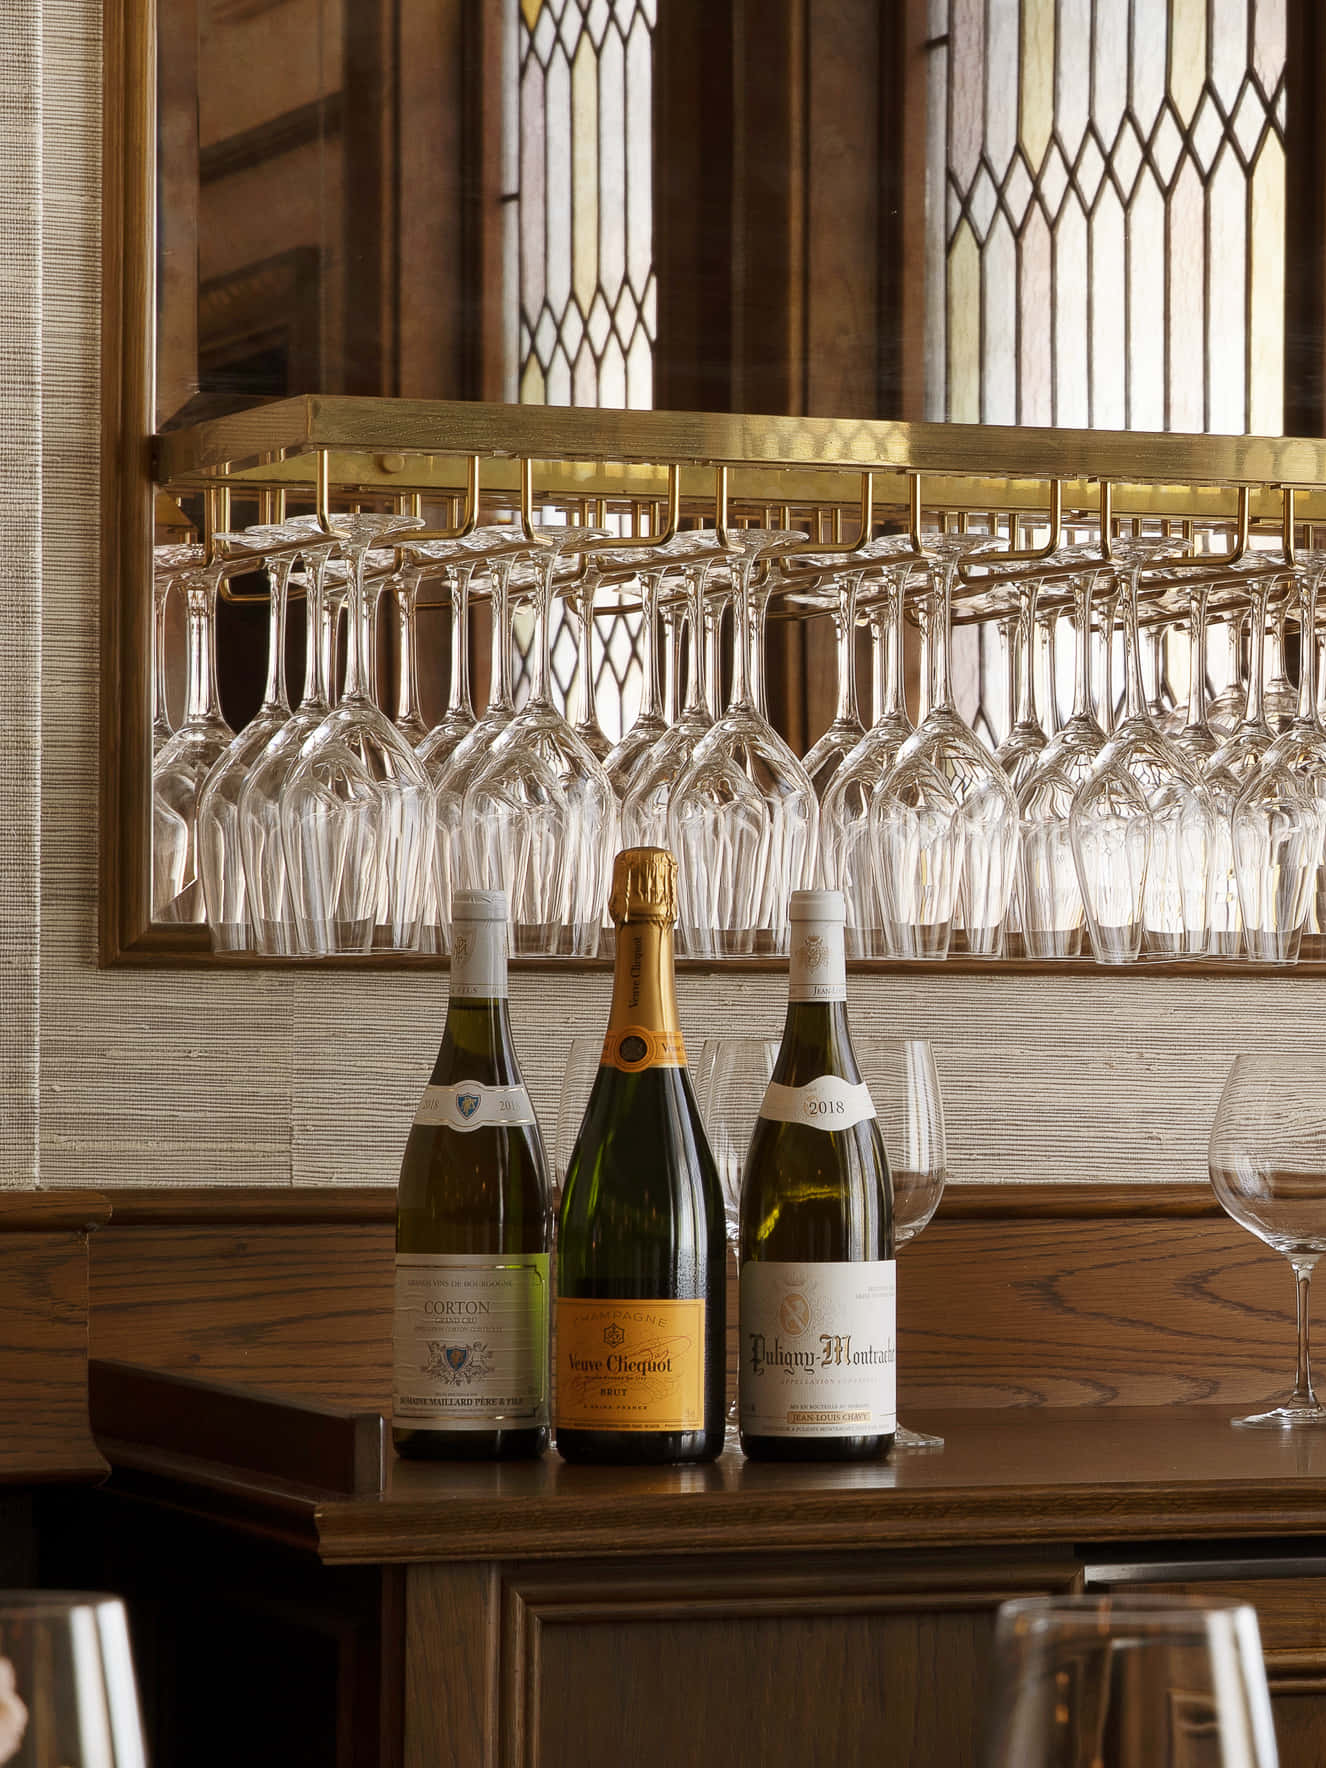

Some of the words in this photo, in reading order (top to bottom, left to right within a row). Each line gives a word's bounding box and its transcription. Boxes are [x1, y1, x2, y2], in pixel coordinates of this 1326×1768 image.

[809, 1101, 845, 1115] 2018
[424, 1300, 491, 1315] CORTON
[568, 1352, 603, 1369] Veuve
[606, 1354, 673, 1376] Clicquot
[599, 1388, 627, 1397] BRUT
[429, 1397, 472, 1407] MAILLARD
